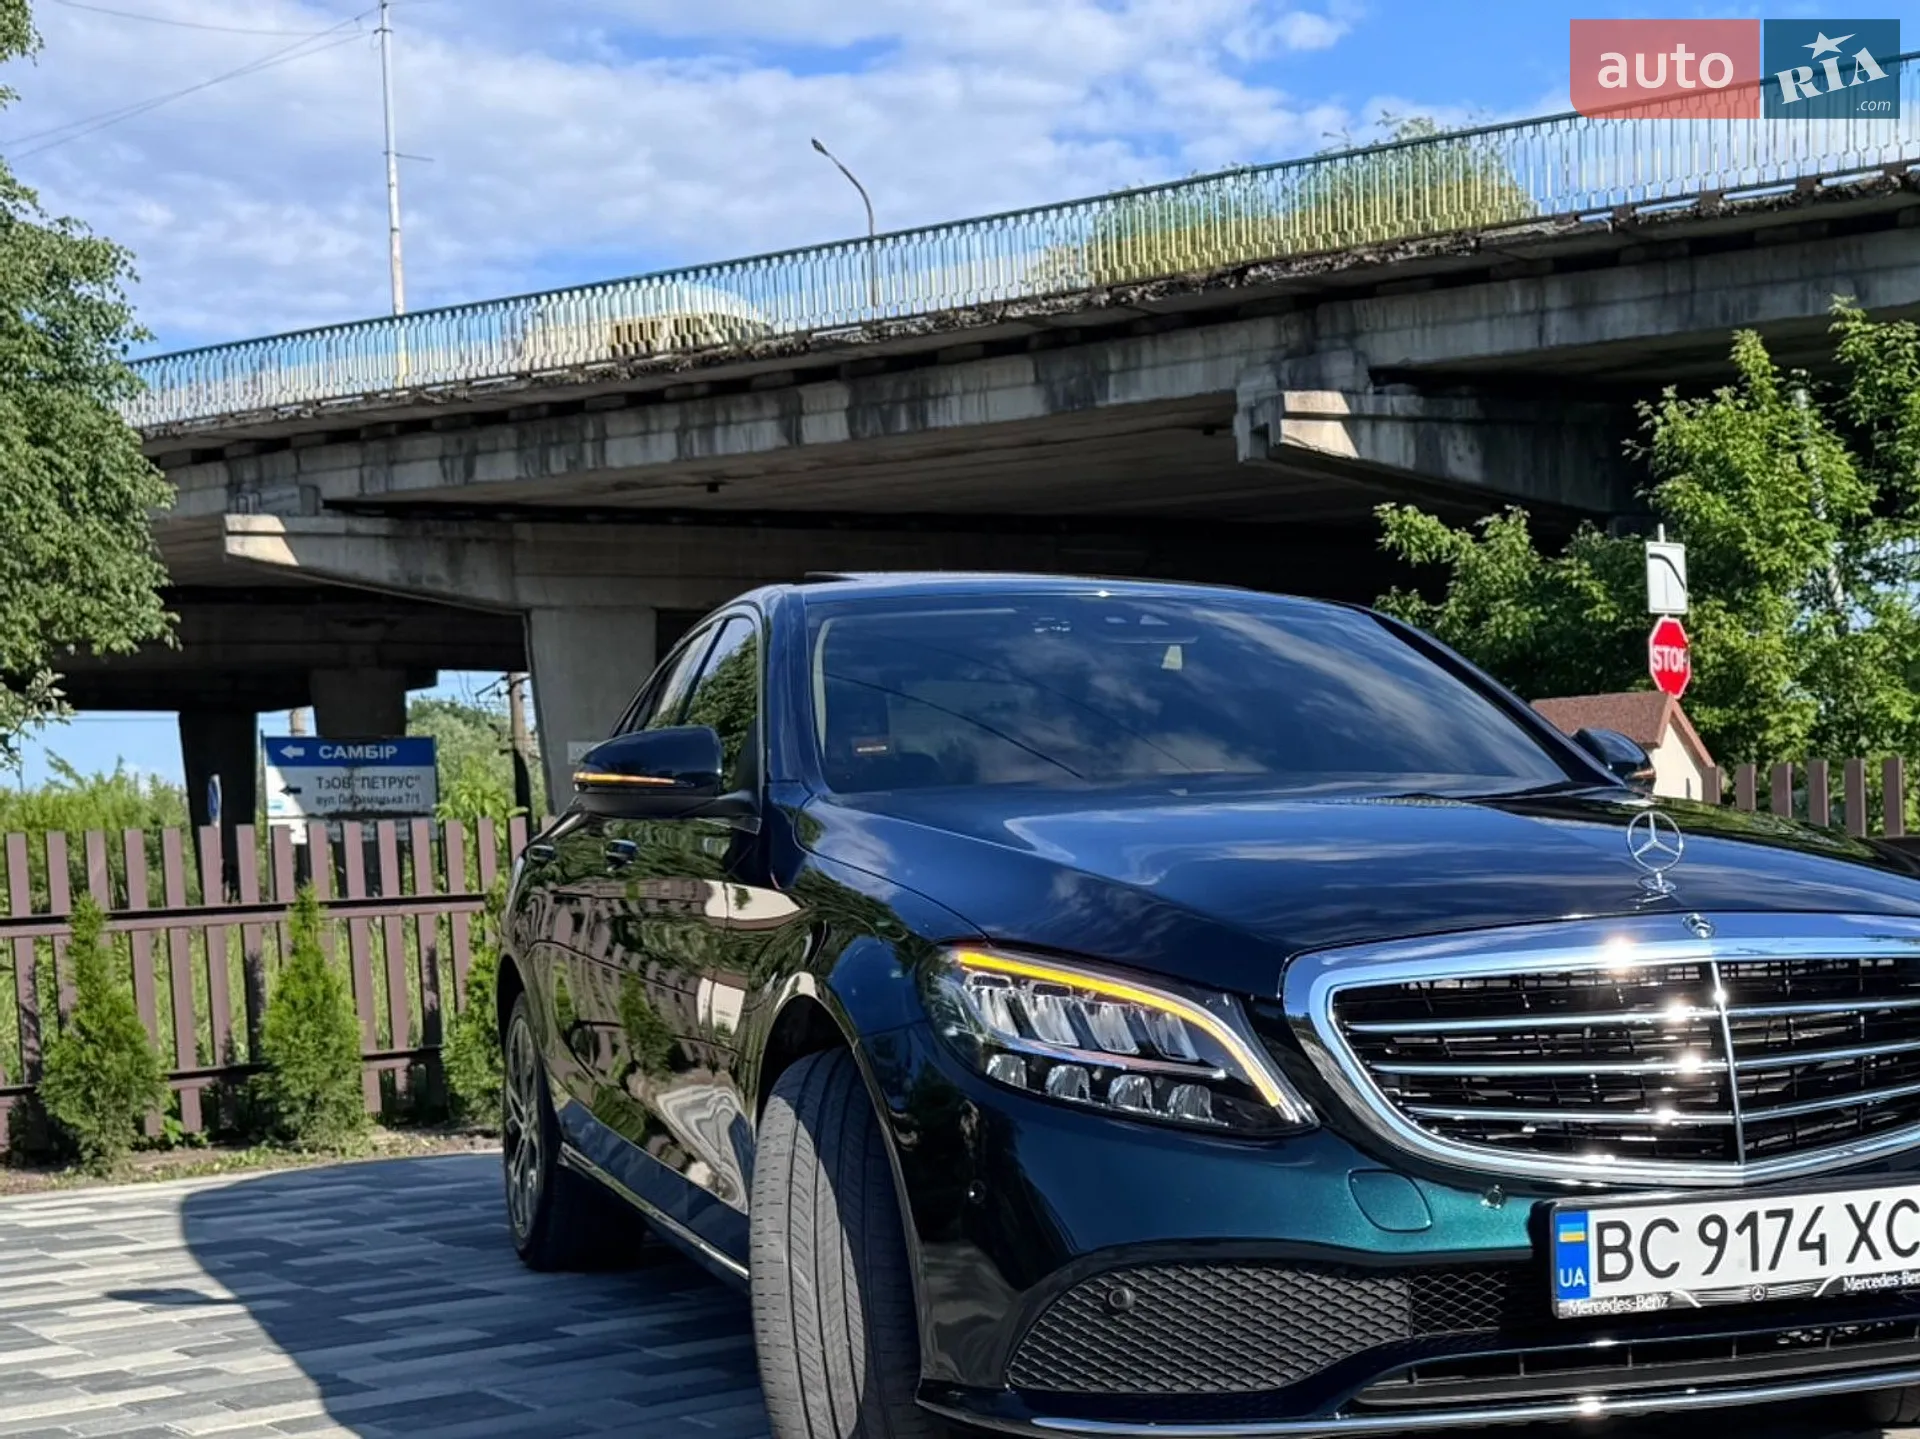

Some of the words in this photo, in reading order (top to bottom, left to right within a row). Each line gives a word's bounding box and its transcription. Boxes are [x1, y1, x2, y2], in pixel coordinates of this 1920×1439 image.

[318, 745, 398, 759] САМБІР
[1596, 1217, 1680, 1283] BC
[1698, 1206, 1827, 1276] 9174
[1844, 1198, 1920, 1264] XC
[1559, 1266, 1587, 1288] UA
